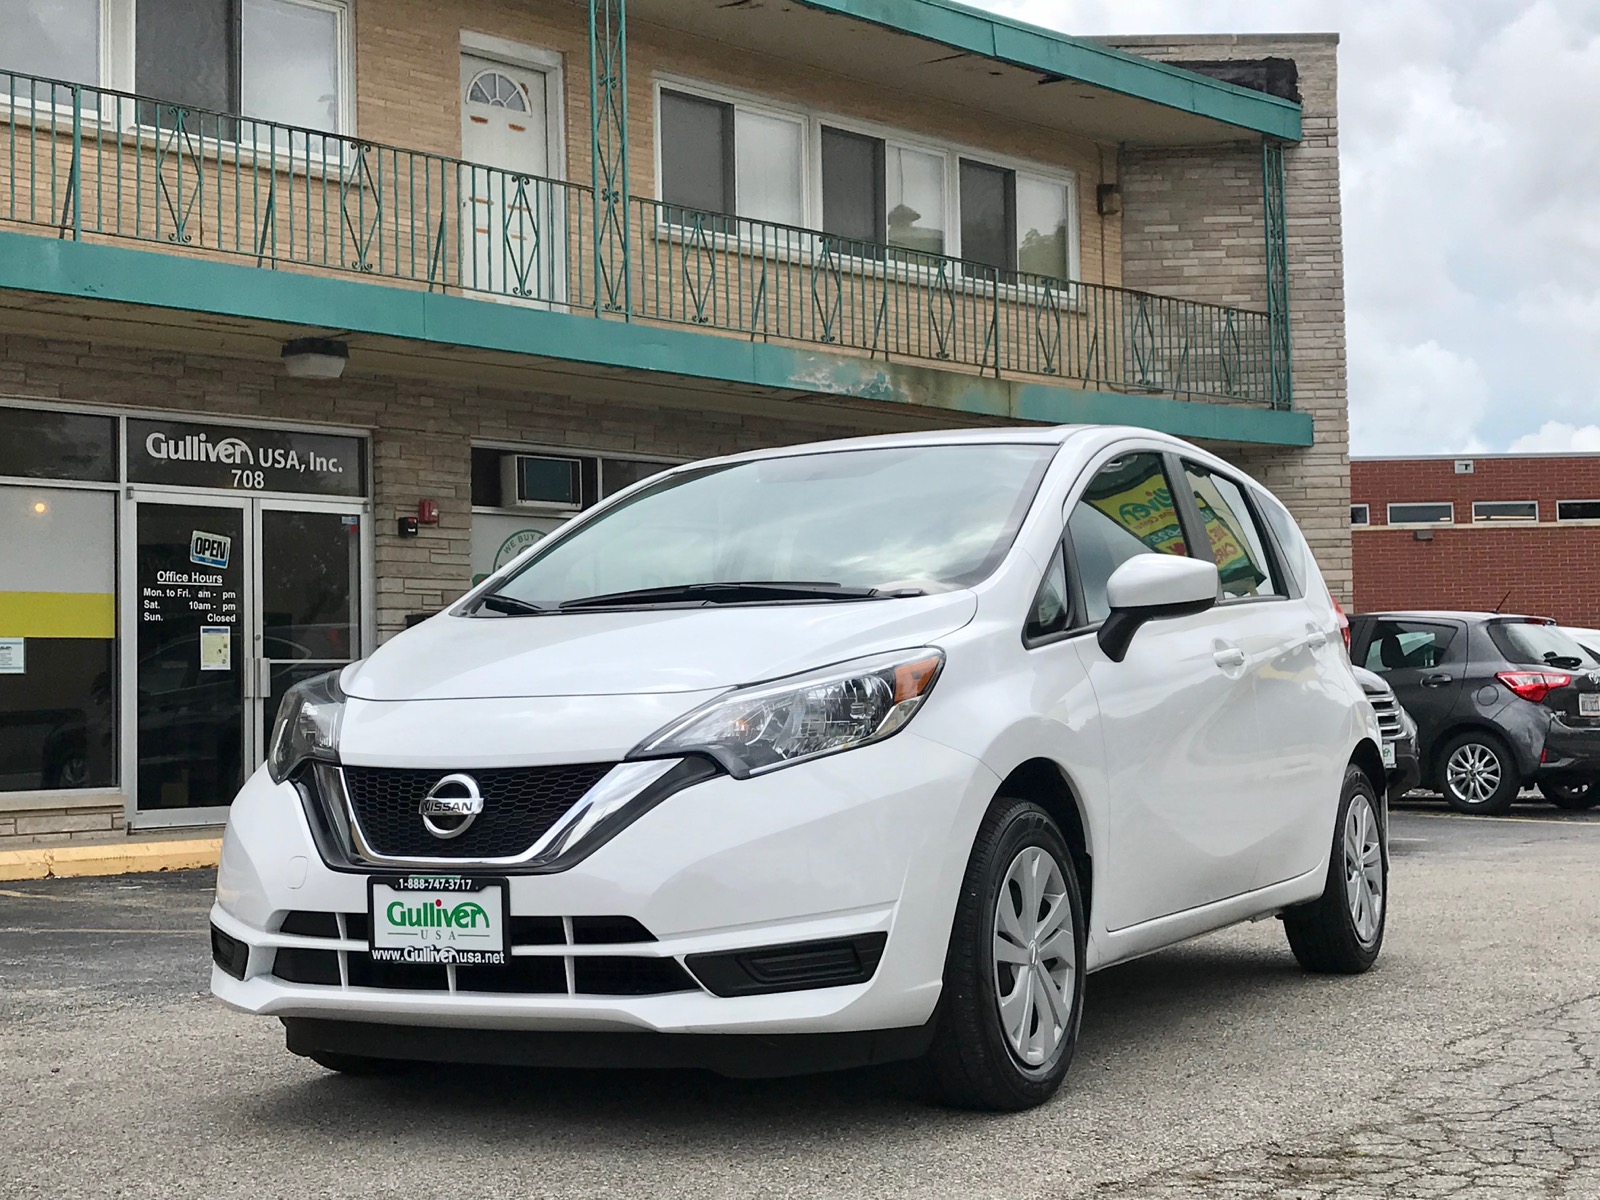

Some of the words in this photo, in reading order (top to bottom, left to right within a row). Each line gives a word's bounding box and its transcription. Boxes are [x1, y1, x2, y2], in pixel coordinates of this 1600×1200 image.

[145, 432, 254, 465] Gulliver
[258, 447, 305, 473] USA,
[309, 451, 343, 473] Inc.
[231, 469, 264, 489] 708
[195, 537, 227, 560] OPEN
[503, 540, 517, 554] WE
[517, 533, 536, 543] BUY
[157, 570, 189, 582] Office
[191, 572, 223, 584] Hours
[143, 587, 165, 597] Mon.
[166, 588, 175, 597] to
[177, 588, 191, 598] Fri.
[197, 590, 211, 598] am
[222, 591, 236, 600] pm
[143, 599, 161, 610] Sat.
[188, 601, 211, 610] 10am
[222, 603, 236, 612] pm
[143, 612, 164, 622] Sun.
[207, 613, 236, 622] Closed
[421, 801, 473, 812] NISSAN
[398, 878, 472, 890] 1-888-747-3717
[386, 899, 490, 929] Gulliver
[371, 944, 505, 964] www.Gulliverusa.net
